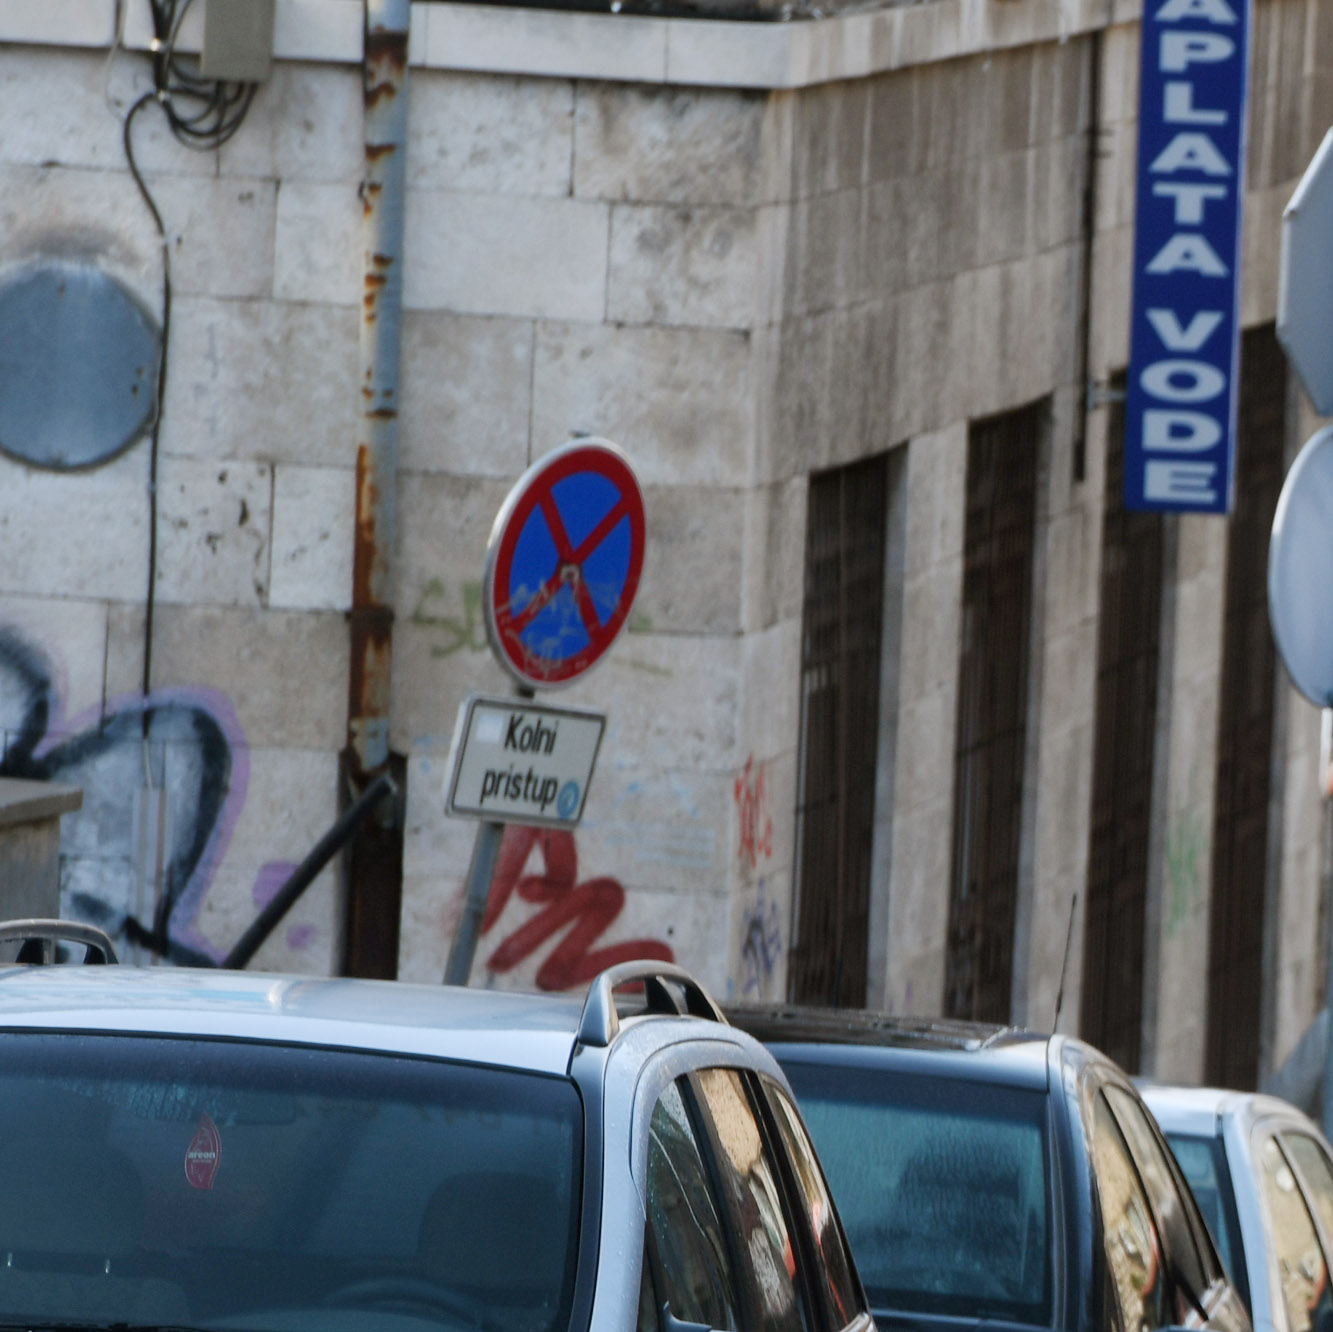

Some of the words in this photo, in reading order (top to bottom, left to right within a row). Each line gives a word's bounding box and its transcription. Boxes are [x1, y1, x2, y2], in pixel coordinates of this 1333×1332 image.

[1140, 308, 1226, 504] VODE
[504, 712, 560, 755] Kolni
[479, 762, 559, 813] pristup
